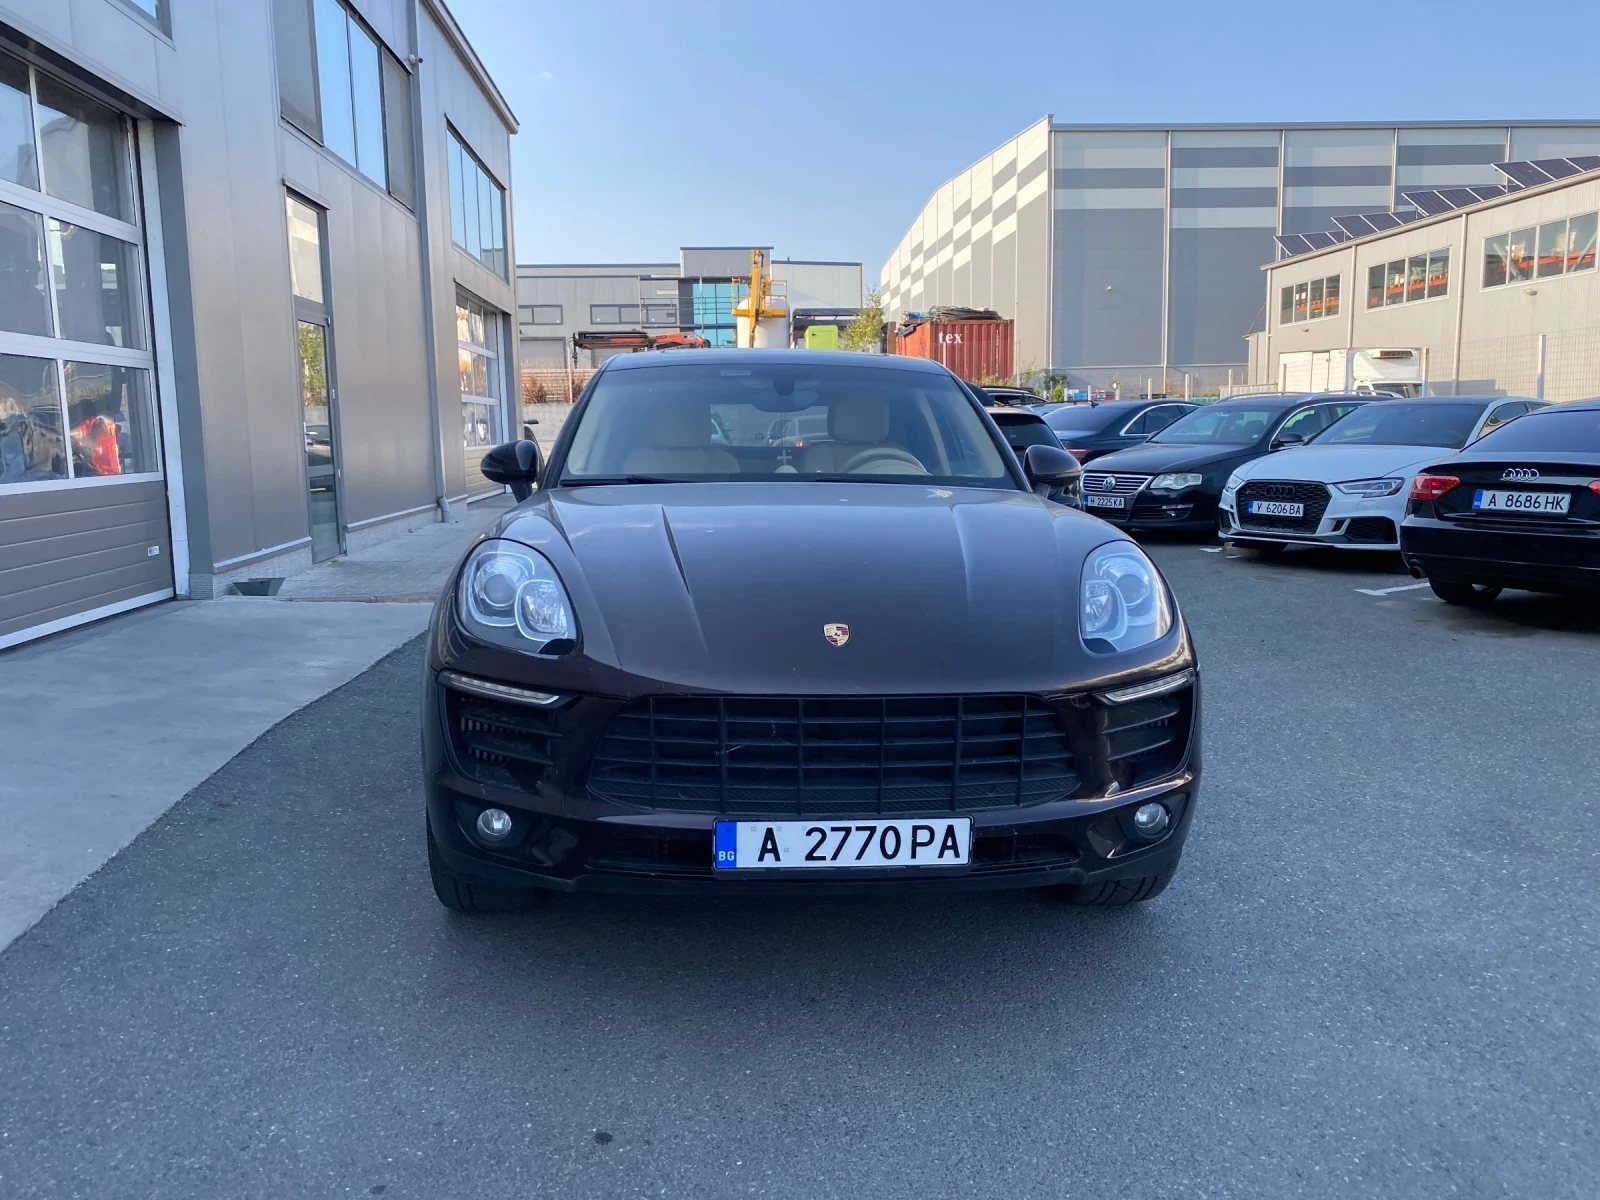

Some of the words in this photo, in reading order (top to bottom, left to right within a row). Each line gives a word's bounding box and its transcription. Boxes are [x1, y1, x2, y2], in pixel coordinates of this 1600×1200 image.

[938, 330, 963, 344] tex
[1488, 493, 1497, 507] A
[757, 827, 782, 862] A
[718, 850, 735, 861] BG
